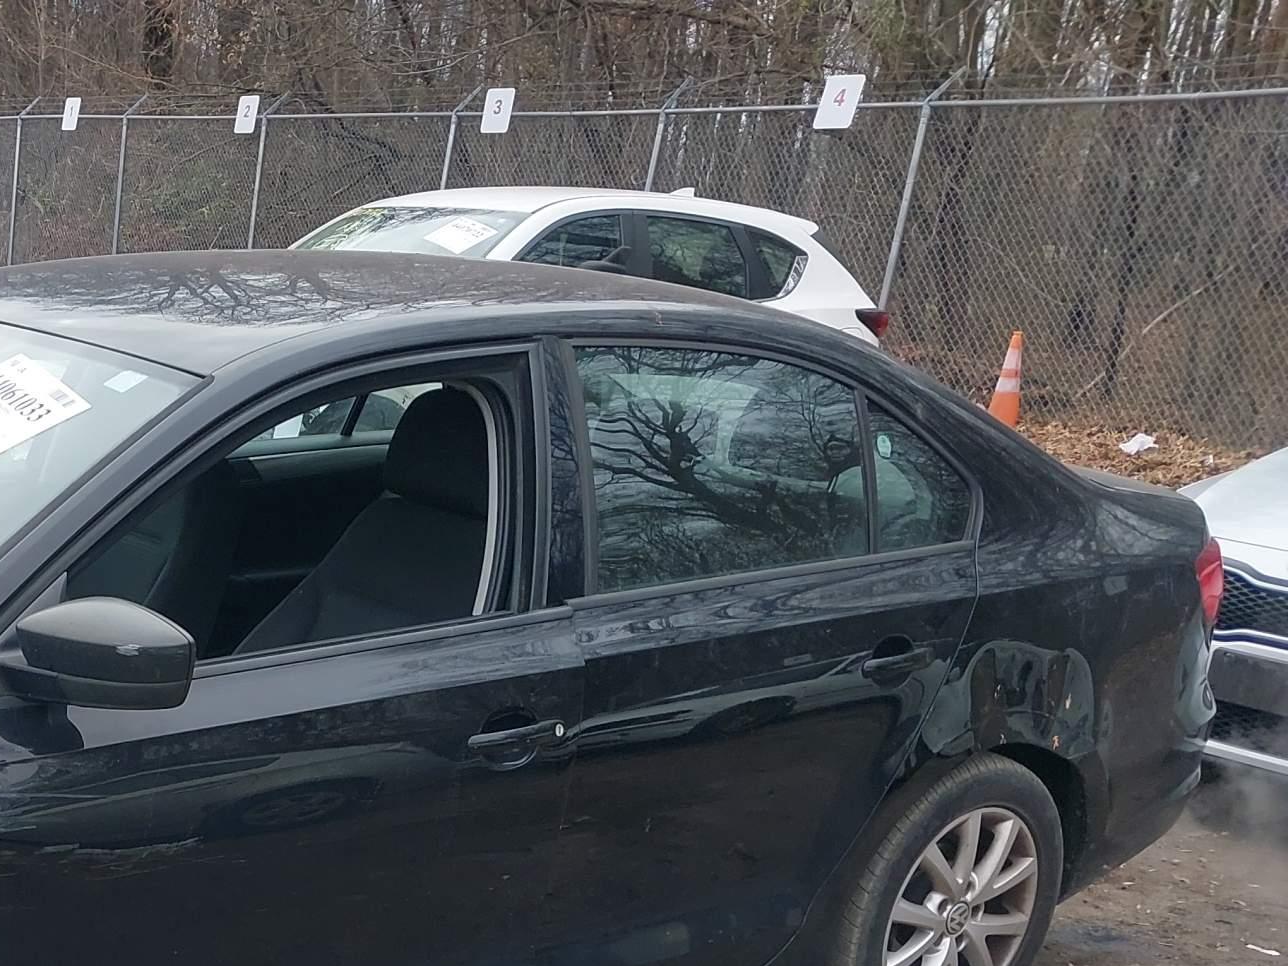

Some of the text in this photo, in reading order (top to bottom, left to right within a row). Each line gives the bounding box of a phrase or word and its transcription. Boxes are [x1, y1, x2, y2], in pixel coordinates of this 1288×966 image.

[833, 88, 847, 107] 4
[243, 104, 251, 118] 2
[493, 99, 503, 115] 3
